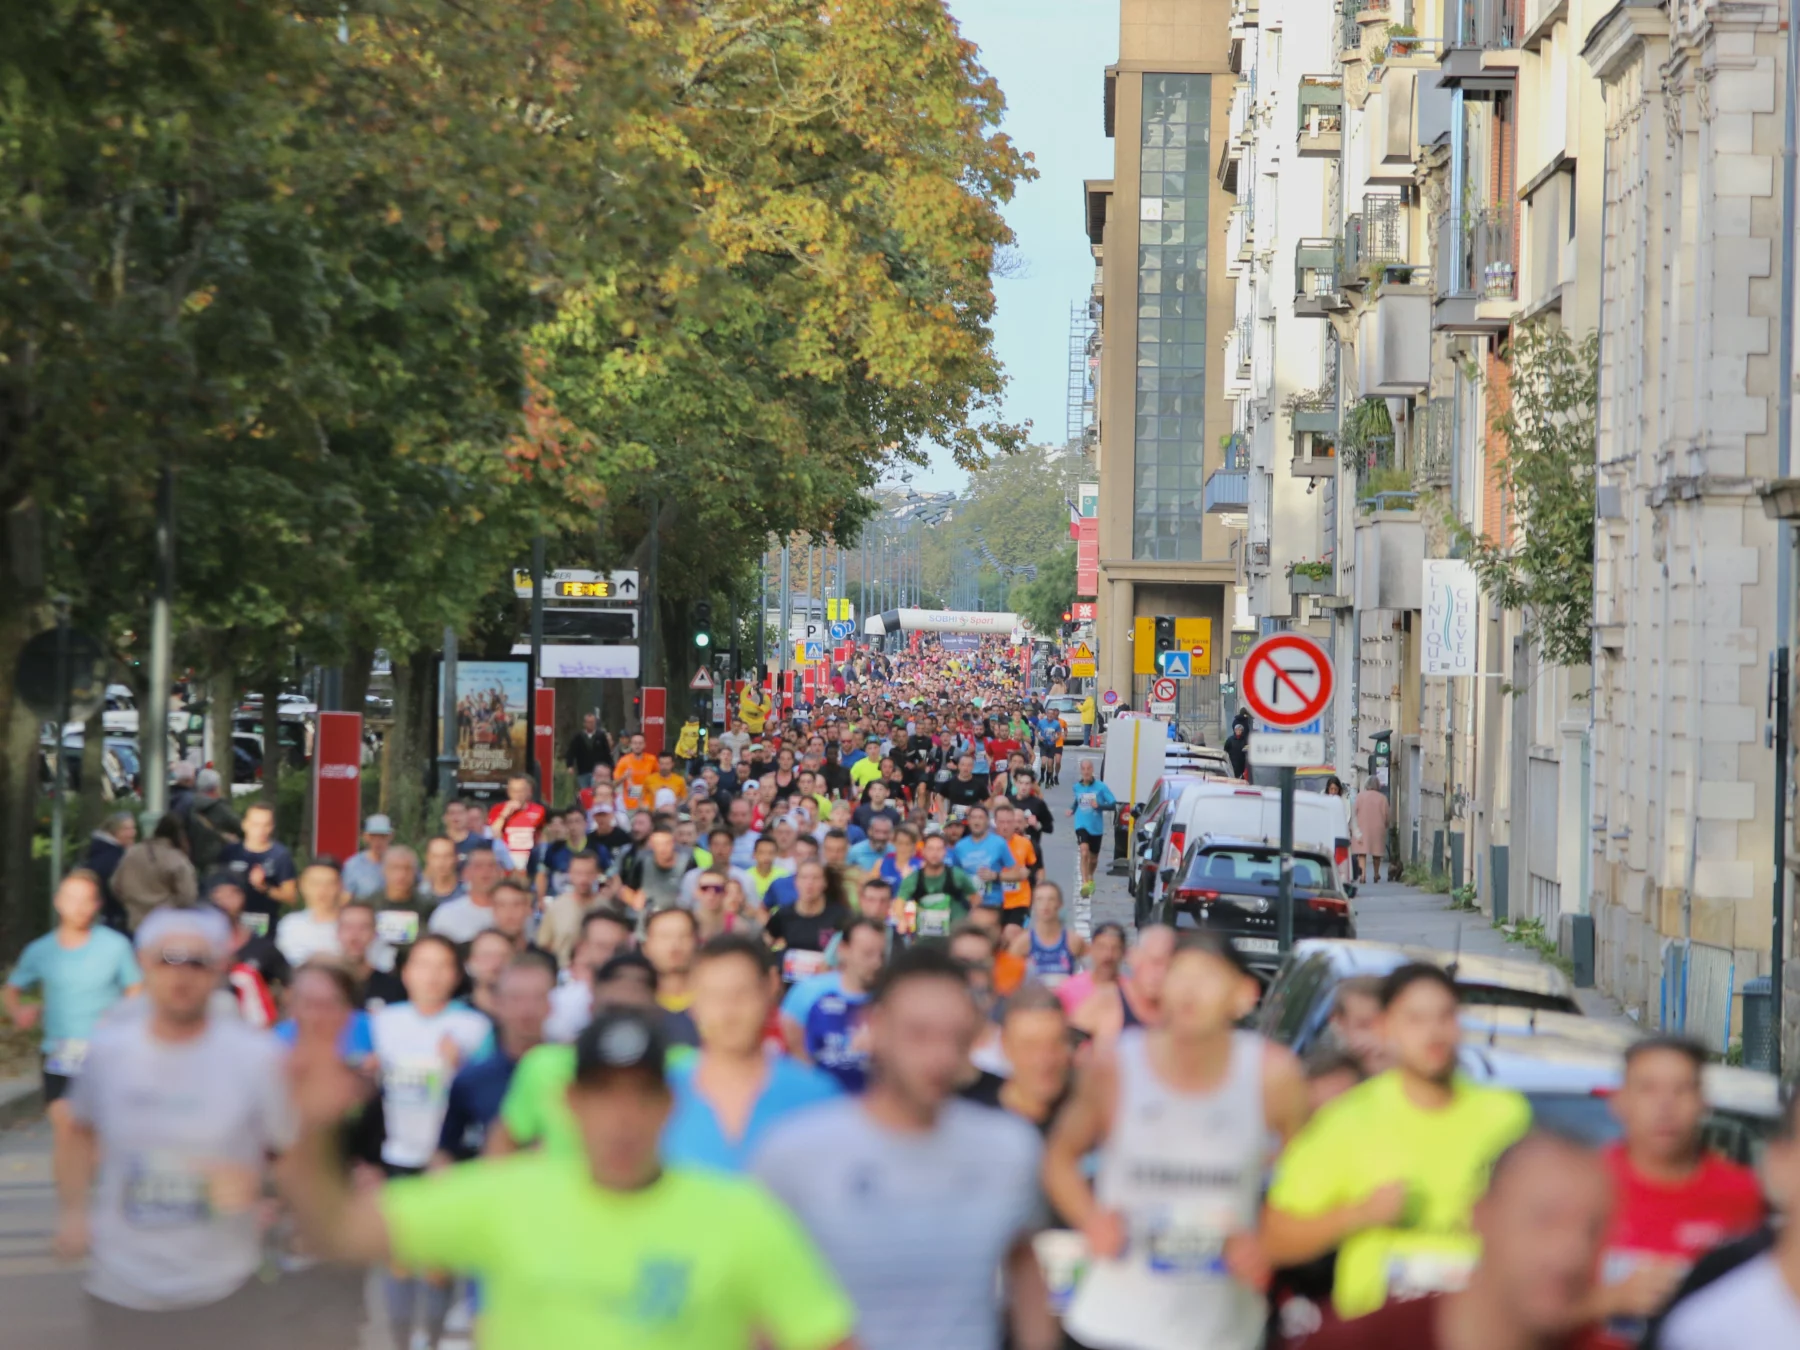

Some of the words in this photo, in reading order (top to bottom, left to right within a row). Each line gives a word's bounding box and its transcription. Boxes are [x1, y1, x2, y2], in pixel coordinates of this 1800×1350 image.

[563, 582, 608, 597] FERME
[928, 614, 958, 623] SOBHI
[970, 616, 994, 626] Sport
[1427, 562, 1442, 672] CLINIQUE
[807, 625, 816, 638] P
[1455, 588, 1469, 668] CHEVEU
[1380, 741, 1388, 754] P
